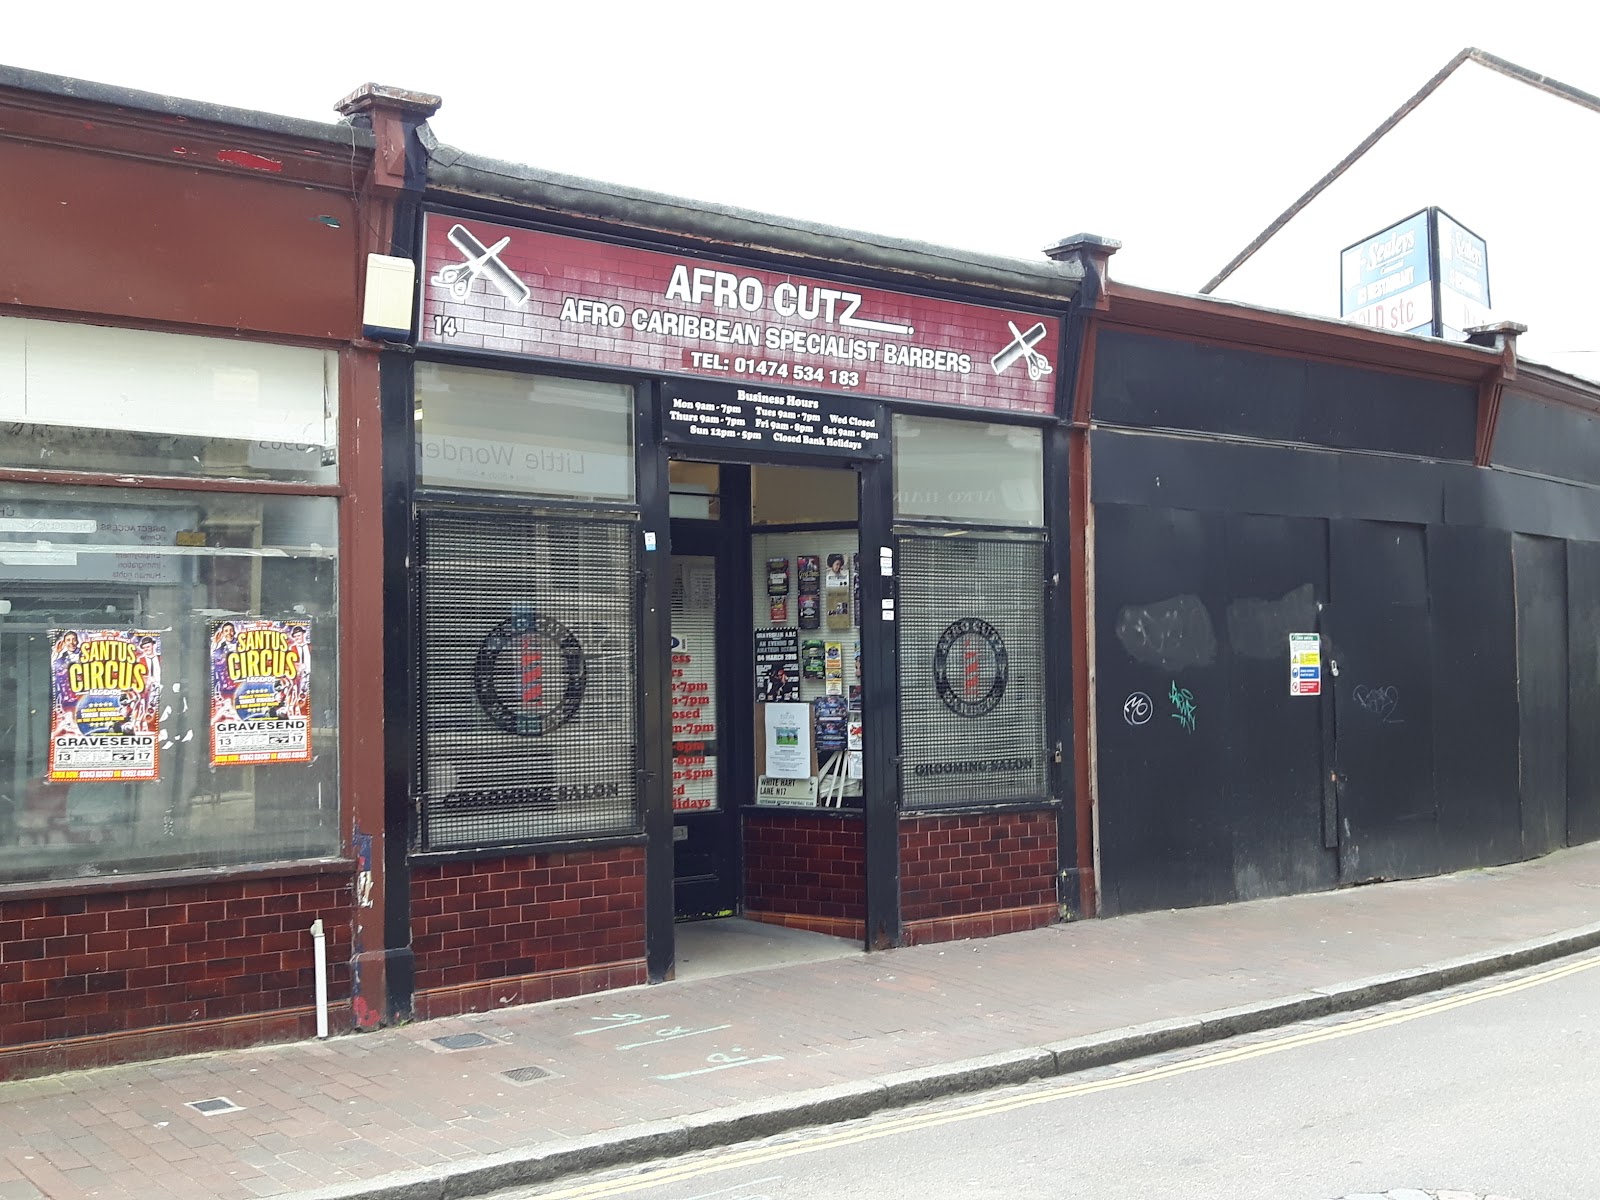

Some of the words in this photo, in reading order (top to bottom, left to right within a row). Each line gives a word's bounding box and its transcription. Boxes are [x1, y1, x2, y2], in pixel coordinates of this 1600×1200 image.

[665, 264, 764, 312] AFRO
[773, 281, 910, 335] CUTZ
[434, 315, 457, 337] 14
[560, 298, 626, 328] AFRO
[631, 308, 760, 346] CARIBBEAN
[765, 327, 880, 362] SPECIALIST
[883, 343, 971, 374] BARBERS
[690, 351, 729, 371] TEL:
[734, 357, 789, 378] 01474
[793, 365, 824, 384] 534
[828, 370, 860, 387] 183
[673, 398, 694, 410] Mon
[695, 402, 715, 412] 9am
[721, 404, 741, 415] 7pm
[737, 390, 785, 406] Business
[786, 395, 819, 409] Hours
[669, 411, 698, 422] Thurs
[699, 414, 719, 424] 9am
[724, 416, 746, 427] 7pm
[755, 406, 776, 417] Tues
[777, 410, 797, 420] 9am
[801, 412, 821, 422] 7pm
[829, 414, 848, 425] Wed
[848, 416, 875, 428] Closed
[690, 425, 710, 435] Sun
[711, 428, 736, 438] 12pm
[741, 431, 762, 441] 5pm
[755, 419, 770, 429] Fri
[770, 421, 790, 431] 9am
[794, 424, 814, 434] 8pm
[822, 426, 837, 436] Sat
[837, 429, 856, 438] 9am
[860, 430, 879, 440] 8pm
[773, 432, 801, 444] Closed
[802, 435, 825, 446] Bank
[826, 437, 862, 450] Holidays
[237, 629, 288, 653] SANTUS
[80, 639, 136, 664] SANTUS
[227, 649, 298, 681] CIRCUS
[69, 661, 147, 693] CIRCUS
[672, 682, 708, 693] -7pm
[672, 708, 700, 719] osed
[216, 721, 305, 732] GRAVESEND
[56, 737, 153, 747] GRAVESEND
[219, 738, 231, 746] 13
[291, 735, 304, 743] 17
[58, 753, 71, 761] 13
[137, 752, 151, 760] 17
[672, 798, 711, 809] lidays
